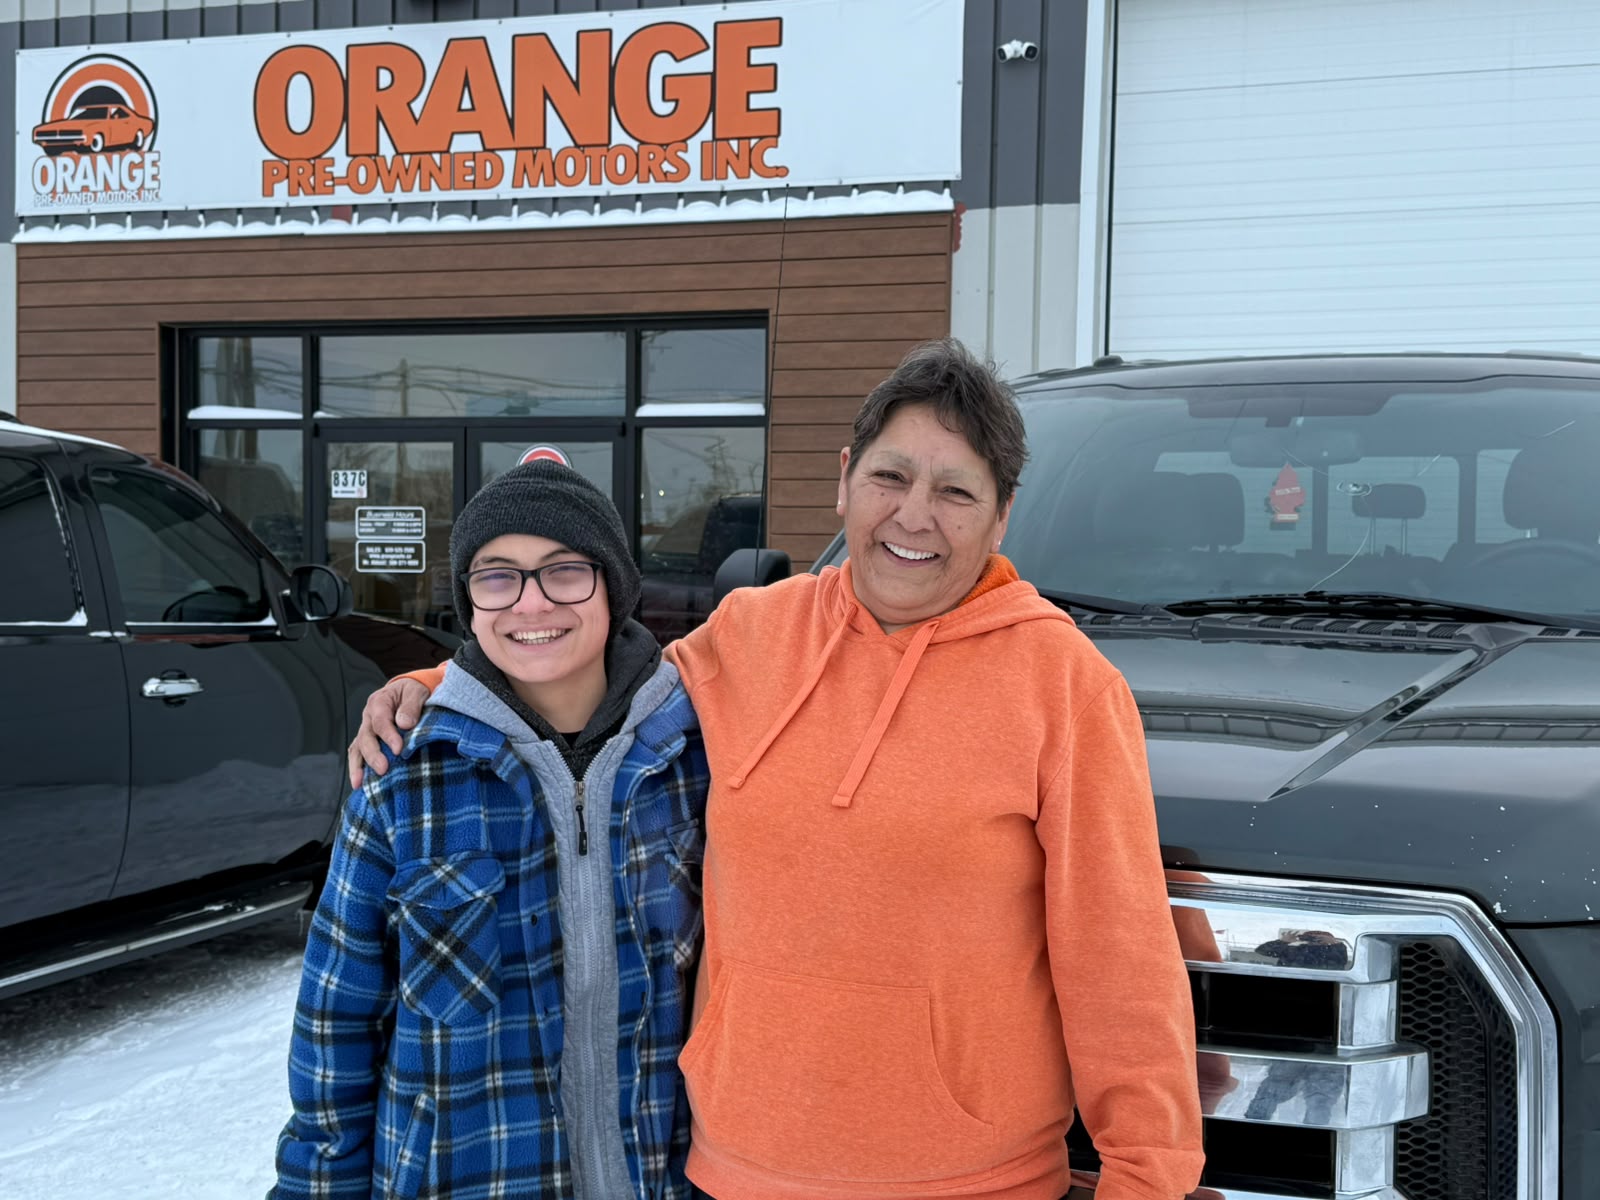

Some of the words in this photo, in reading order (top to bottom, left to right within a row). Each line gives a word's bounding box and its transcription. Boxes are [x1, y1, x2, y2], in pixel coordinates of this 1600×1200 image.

[254, 17, 782, 161] ORANGE
[32, 151, 161, 194] ORANGE
[262, 151, 504, 197] PRE-OWNED
[512, 141, 691, 188] MOTORS
[700, 137, 789, 180] INC.
[97, 190, 139, 203] MOTORS
[333, 471, 366, 487] 837C
